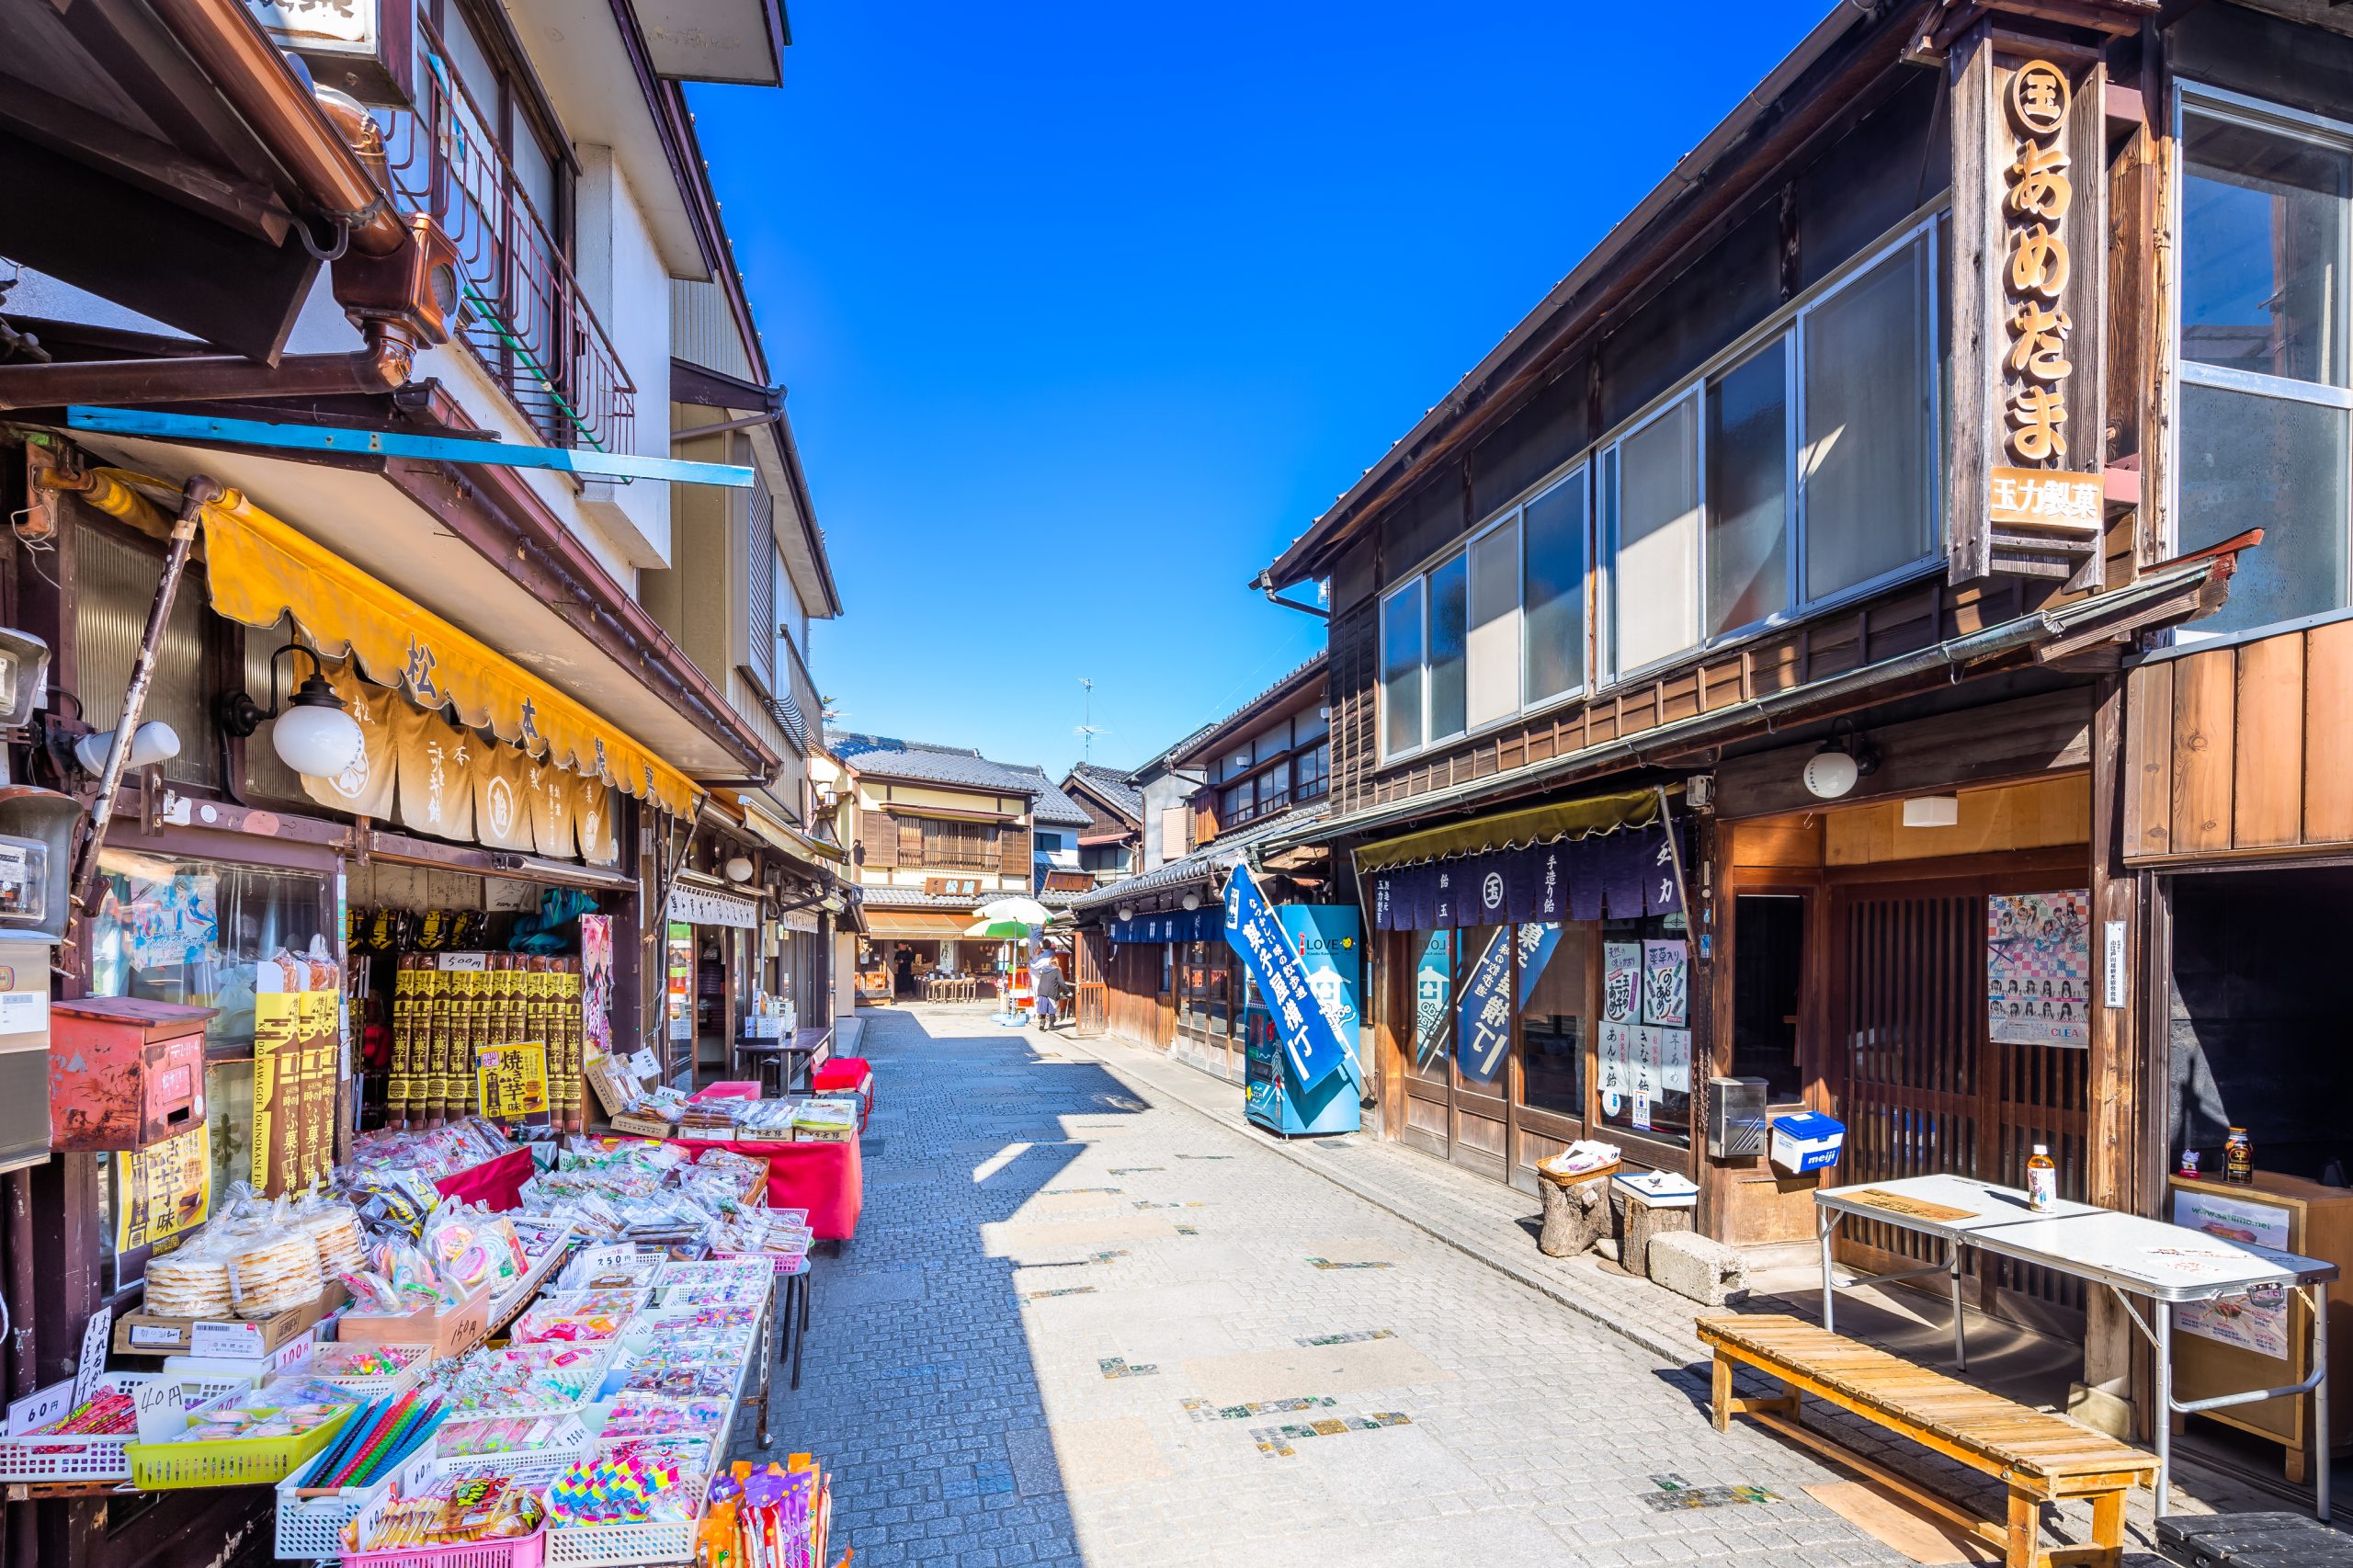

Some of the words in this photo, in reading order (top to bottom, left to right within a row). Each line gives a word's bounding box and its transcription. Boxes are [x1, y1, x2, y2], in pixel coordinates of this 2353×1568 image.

[2011, 138, 2073, 460] あめだま
[1992, 478, 2099, 518] 玉力製菓
[1439, 874, 1449, 917] 飴玉
[1543, 855, 1557, 913] 手造り飴
[1307, 939, 1339, 950] LOVE
[1648, 947, 1679, 965] 薬草入り
[1242, 919, 1313, 1059] 菓子屋横丁
[256, 1058, 265, 1107] KAWAGOE
[501, 1050, 526, 1112] 焼き芋味
[1606, 1028, 1617, 1087] あんこ飴
[1638, 1029, 1649, 1091] きなこ飴
[1670, 1033, 1680, 1083] 芋あめ
[255, 1109, 263, 1172] TOKINOKANE
[283, 1113, 298, 1192] ふ菓子棒
[303, 1109, 319, 1185] ふ菓子棒
[1808, 1150, 1836, 1165] meiji
[281, 1343, 310, 1368] 100円
[28, 1400, 59, 1422] 60円
[141, 1385, 183, 1413] 40円
